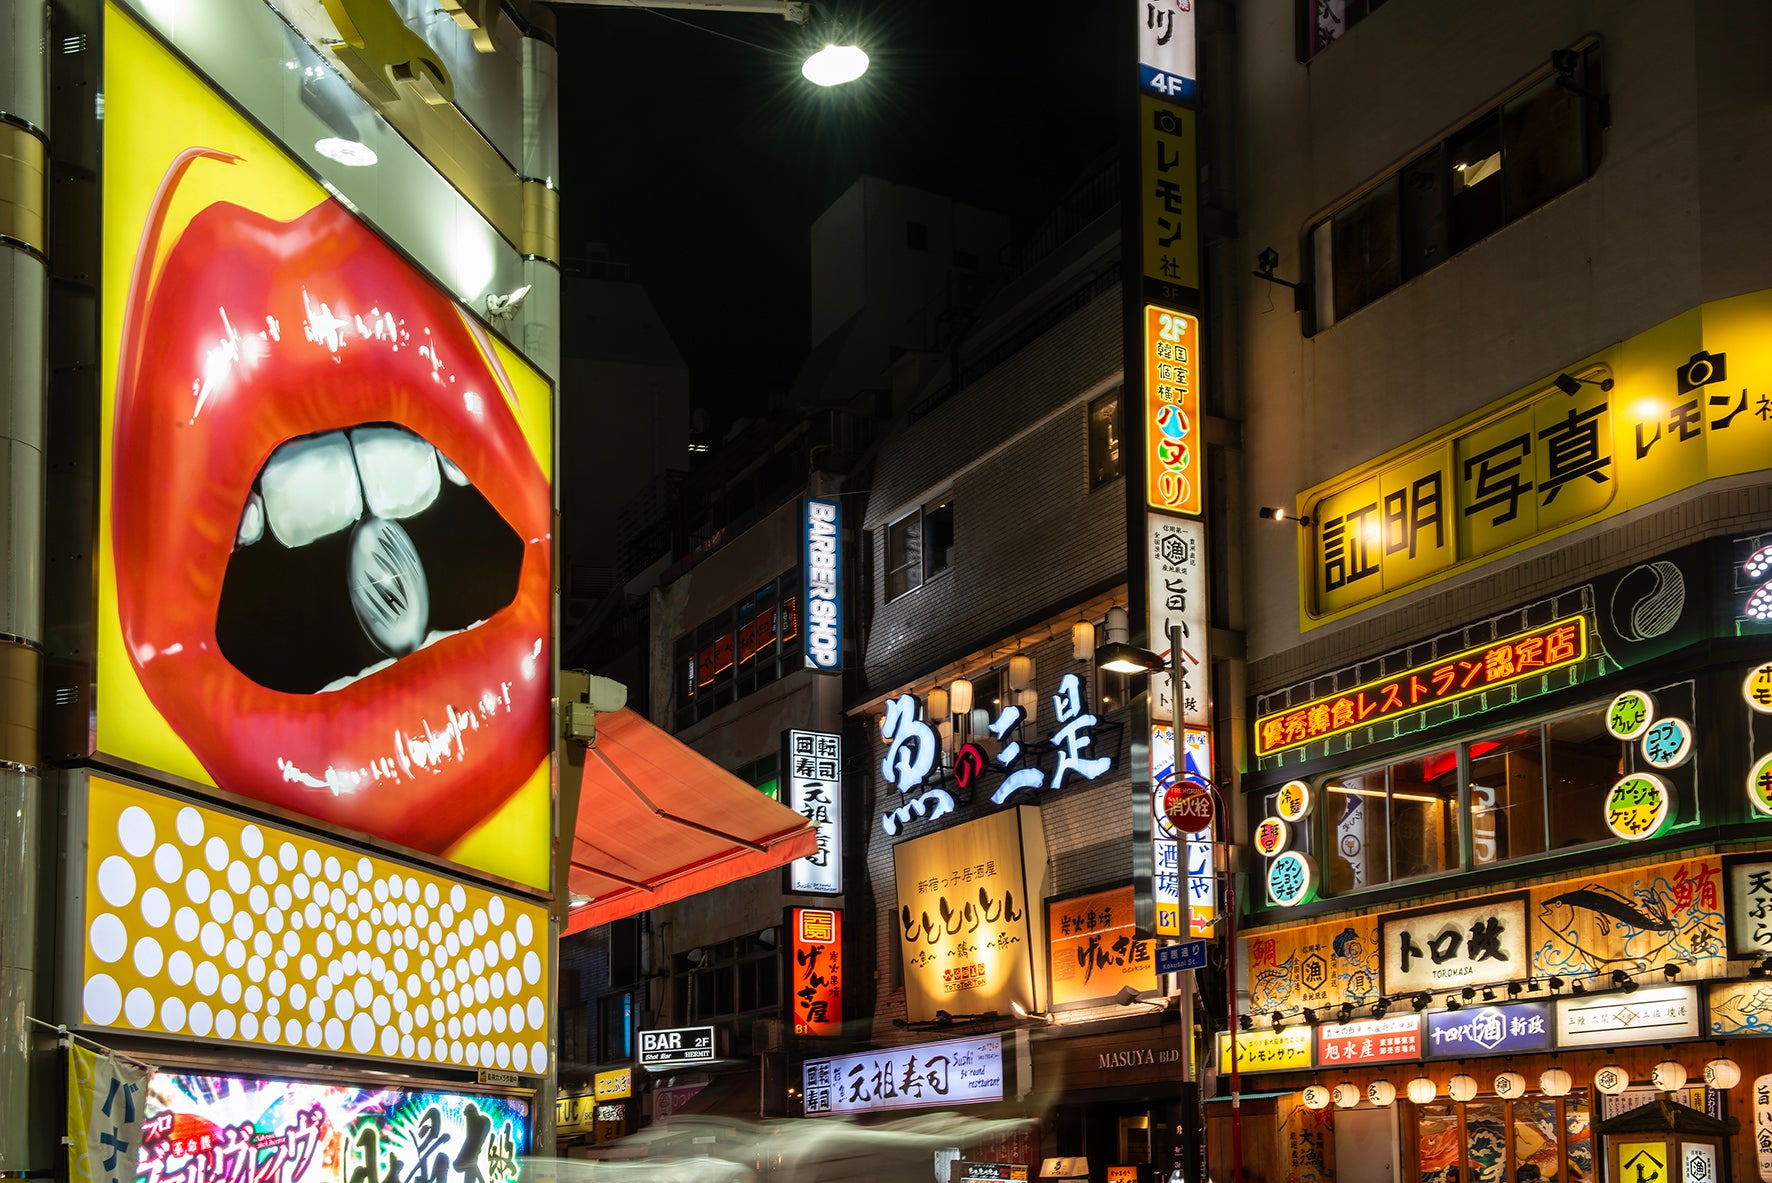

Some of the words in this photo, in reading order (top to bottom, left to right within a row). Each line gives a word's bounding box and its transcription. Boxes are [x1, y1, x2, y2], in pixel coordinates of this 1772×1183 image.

[1150, 72, 1183, 96] 4F
[1155, 141, 1183, 280] レモン社
[1158, 312, 1188, 343] 2F
[1157, 342, 1188, 364] 韓国
[1158, 362, 1188, 386] 個室
[1158, 384, 1189, 404] 横丁
[1635, 388, 1772, 461] レモン社
[1157, 406, 1190, 506] ハヌリ
[1322, 401, 1612, 594] 証明写真
[809, 501, 837, 600] BARBER
[1166, 540, 1184, 560] 漁
[809, 599, 838, 667] SHOP
[1262, 624, 1575, 750] 優秀韓食レストラン認定店
[1160, 693, 1198, 712] ト政
[796, 736, 837, 758] 回転
[796, 757, 837, 779] 寿司
[1182, 787, 1204, 795] HYDRANT
[1168, 797, 1211, 818] 消火栓
[917, 861, 997, 895] 新宿っ子居酒屋
[1158, 843, 1178, 898] 酒場
[902, 886, 1023, 945] とととりとん
[1061, 906, 1113, 936] 炭火串焼
[1159, 910, 1177, 929] B1
[1160, 944, 1200, 962] 国際通り
[1400, 916, 1510, 974] トロ政
[1077, 933, 1151, 986] げんき屋
[1162, 960, 1187, 970] Kokusai
[1187, 958, 1198, 966] St.
[1306, 961, 1323, 982] 漁
[1432, 966, 1474, 979] TOROMASA
[797, 944, 830, 1023] げんき屋
[794, 1024, 808, 1035] B1
[1476, 1015, 1501, 1042] 酒
[1509, 1014, 1546, 1037] 新政
[644, 1032, 682, 1051] BAR
[695, 1037, 709, 1048] 2F
[1324, 1038, 1375, 1060] 旭水産
[660, 1052, 672, 1060] Bar
[684, 1050, 710, 1058] HERMIT
[953, 1050, 974, 1067] Sushi
[1099, 1048, 1155, 1069] MASUYA
[1159, 1049, 1179, 1063] BLD
[1249, 1048, 1305, 1063] レモンサワー
[848, 1054, 950, 1103] 元祖寿司
[968, 1076, 1001, 1088] restaurant
[100, 1077, 139, 1183] バナ
[1299, 1128, 1318, 1166] 大漁
